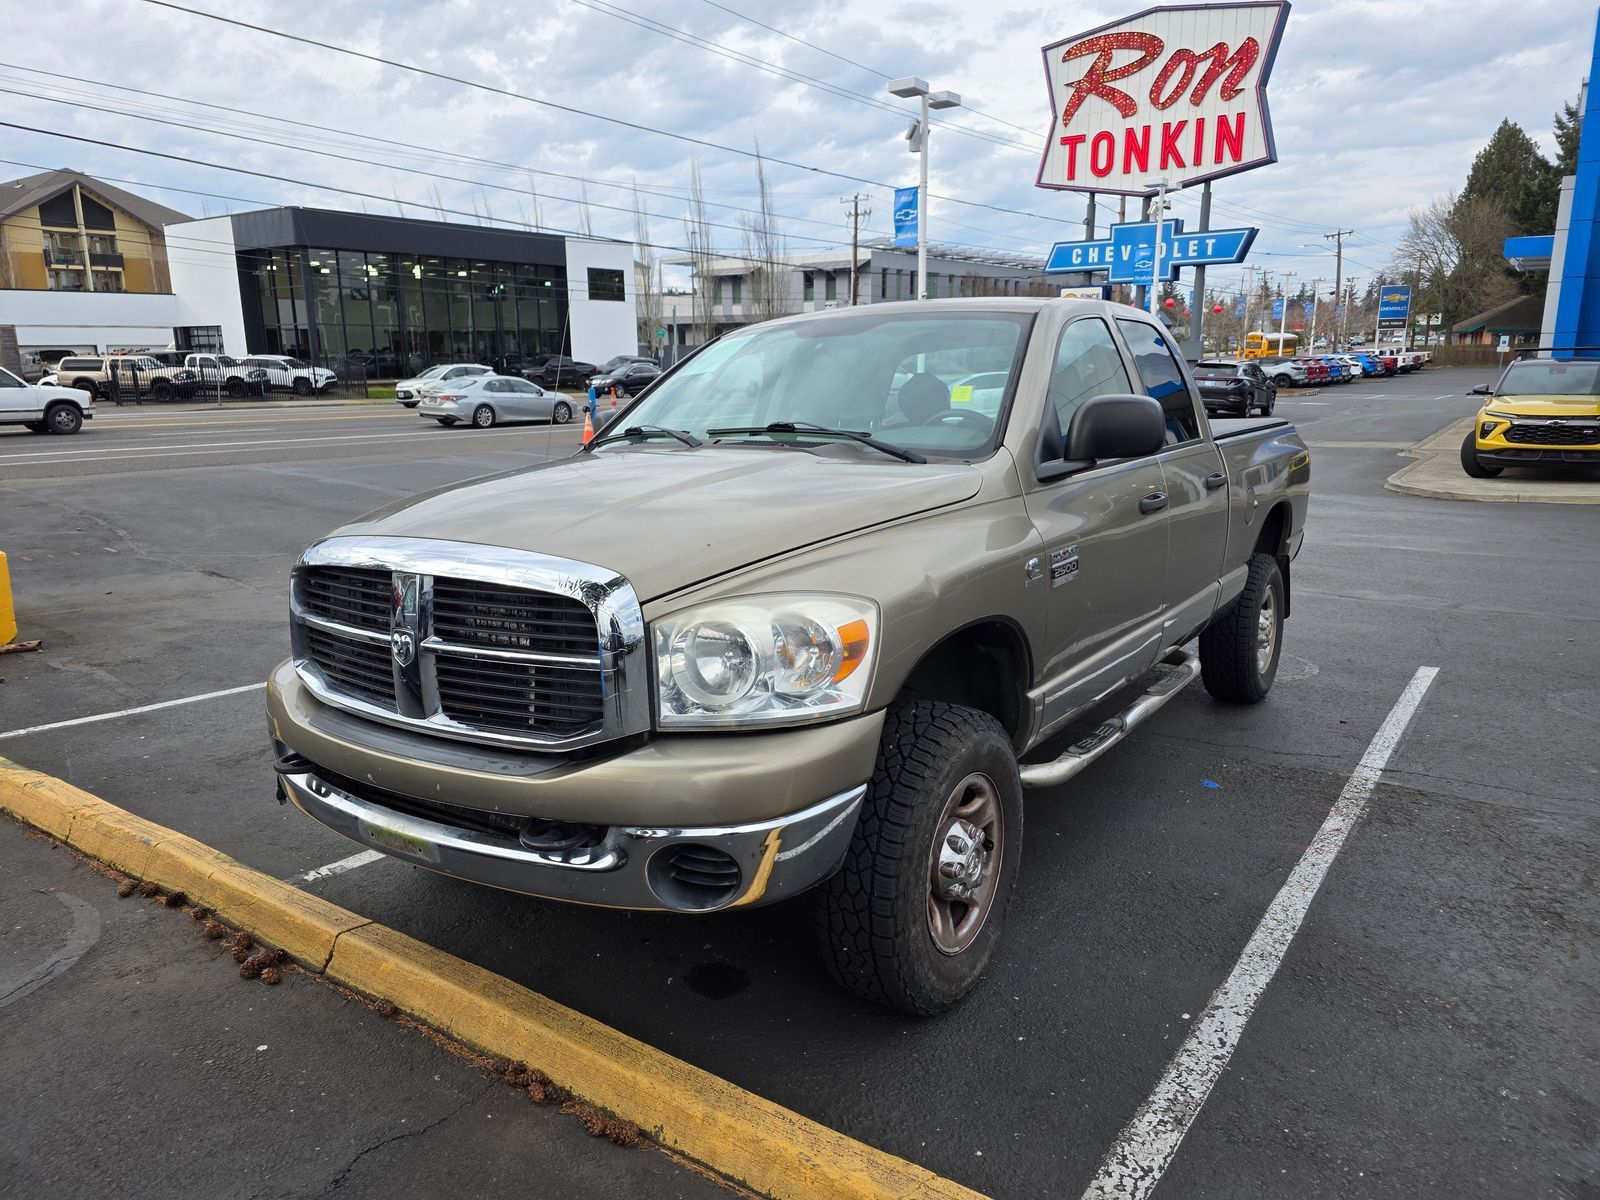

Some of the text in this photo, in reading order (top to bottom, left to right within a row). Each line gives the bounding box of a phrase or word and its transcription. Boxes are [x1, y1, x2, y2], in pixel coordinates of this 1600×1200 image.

[1062, 32, 1259, 127] Ron
[1061, 112, 1245, 181] TONKIN
[1072, 239, 1216, 265] CHEVOLET
[1054, 561, 1077, 578] 2500
